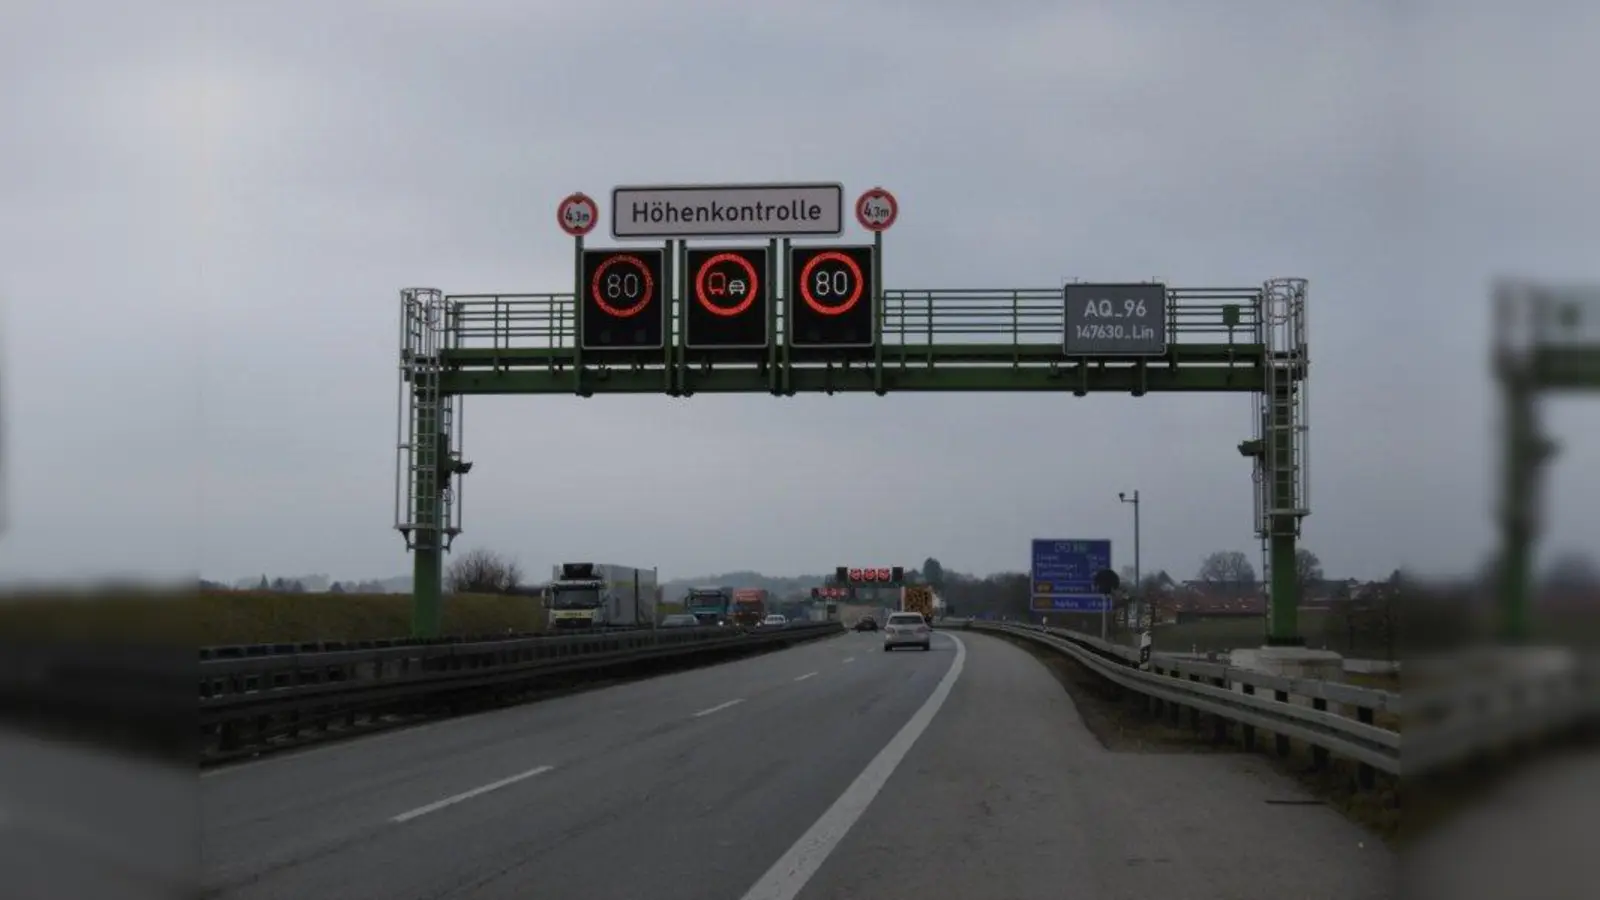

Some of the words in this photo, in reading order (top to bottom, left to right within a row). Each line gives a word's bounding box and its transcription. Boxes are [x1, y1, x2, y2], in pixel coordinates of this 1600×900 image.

[632, 201, 821, 223] Höhenkontrolle
[607, 273, 638, 298] 80
[816, 271, 848, 295] 80
[1084, 299, 1147, 317] AQ_96
